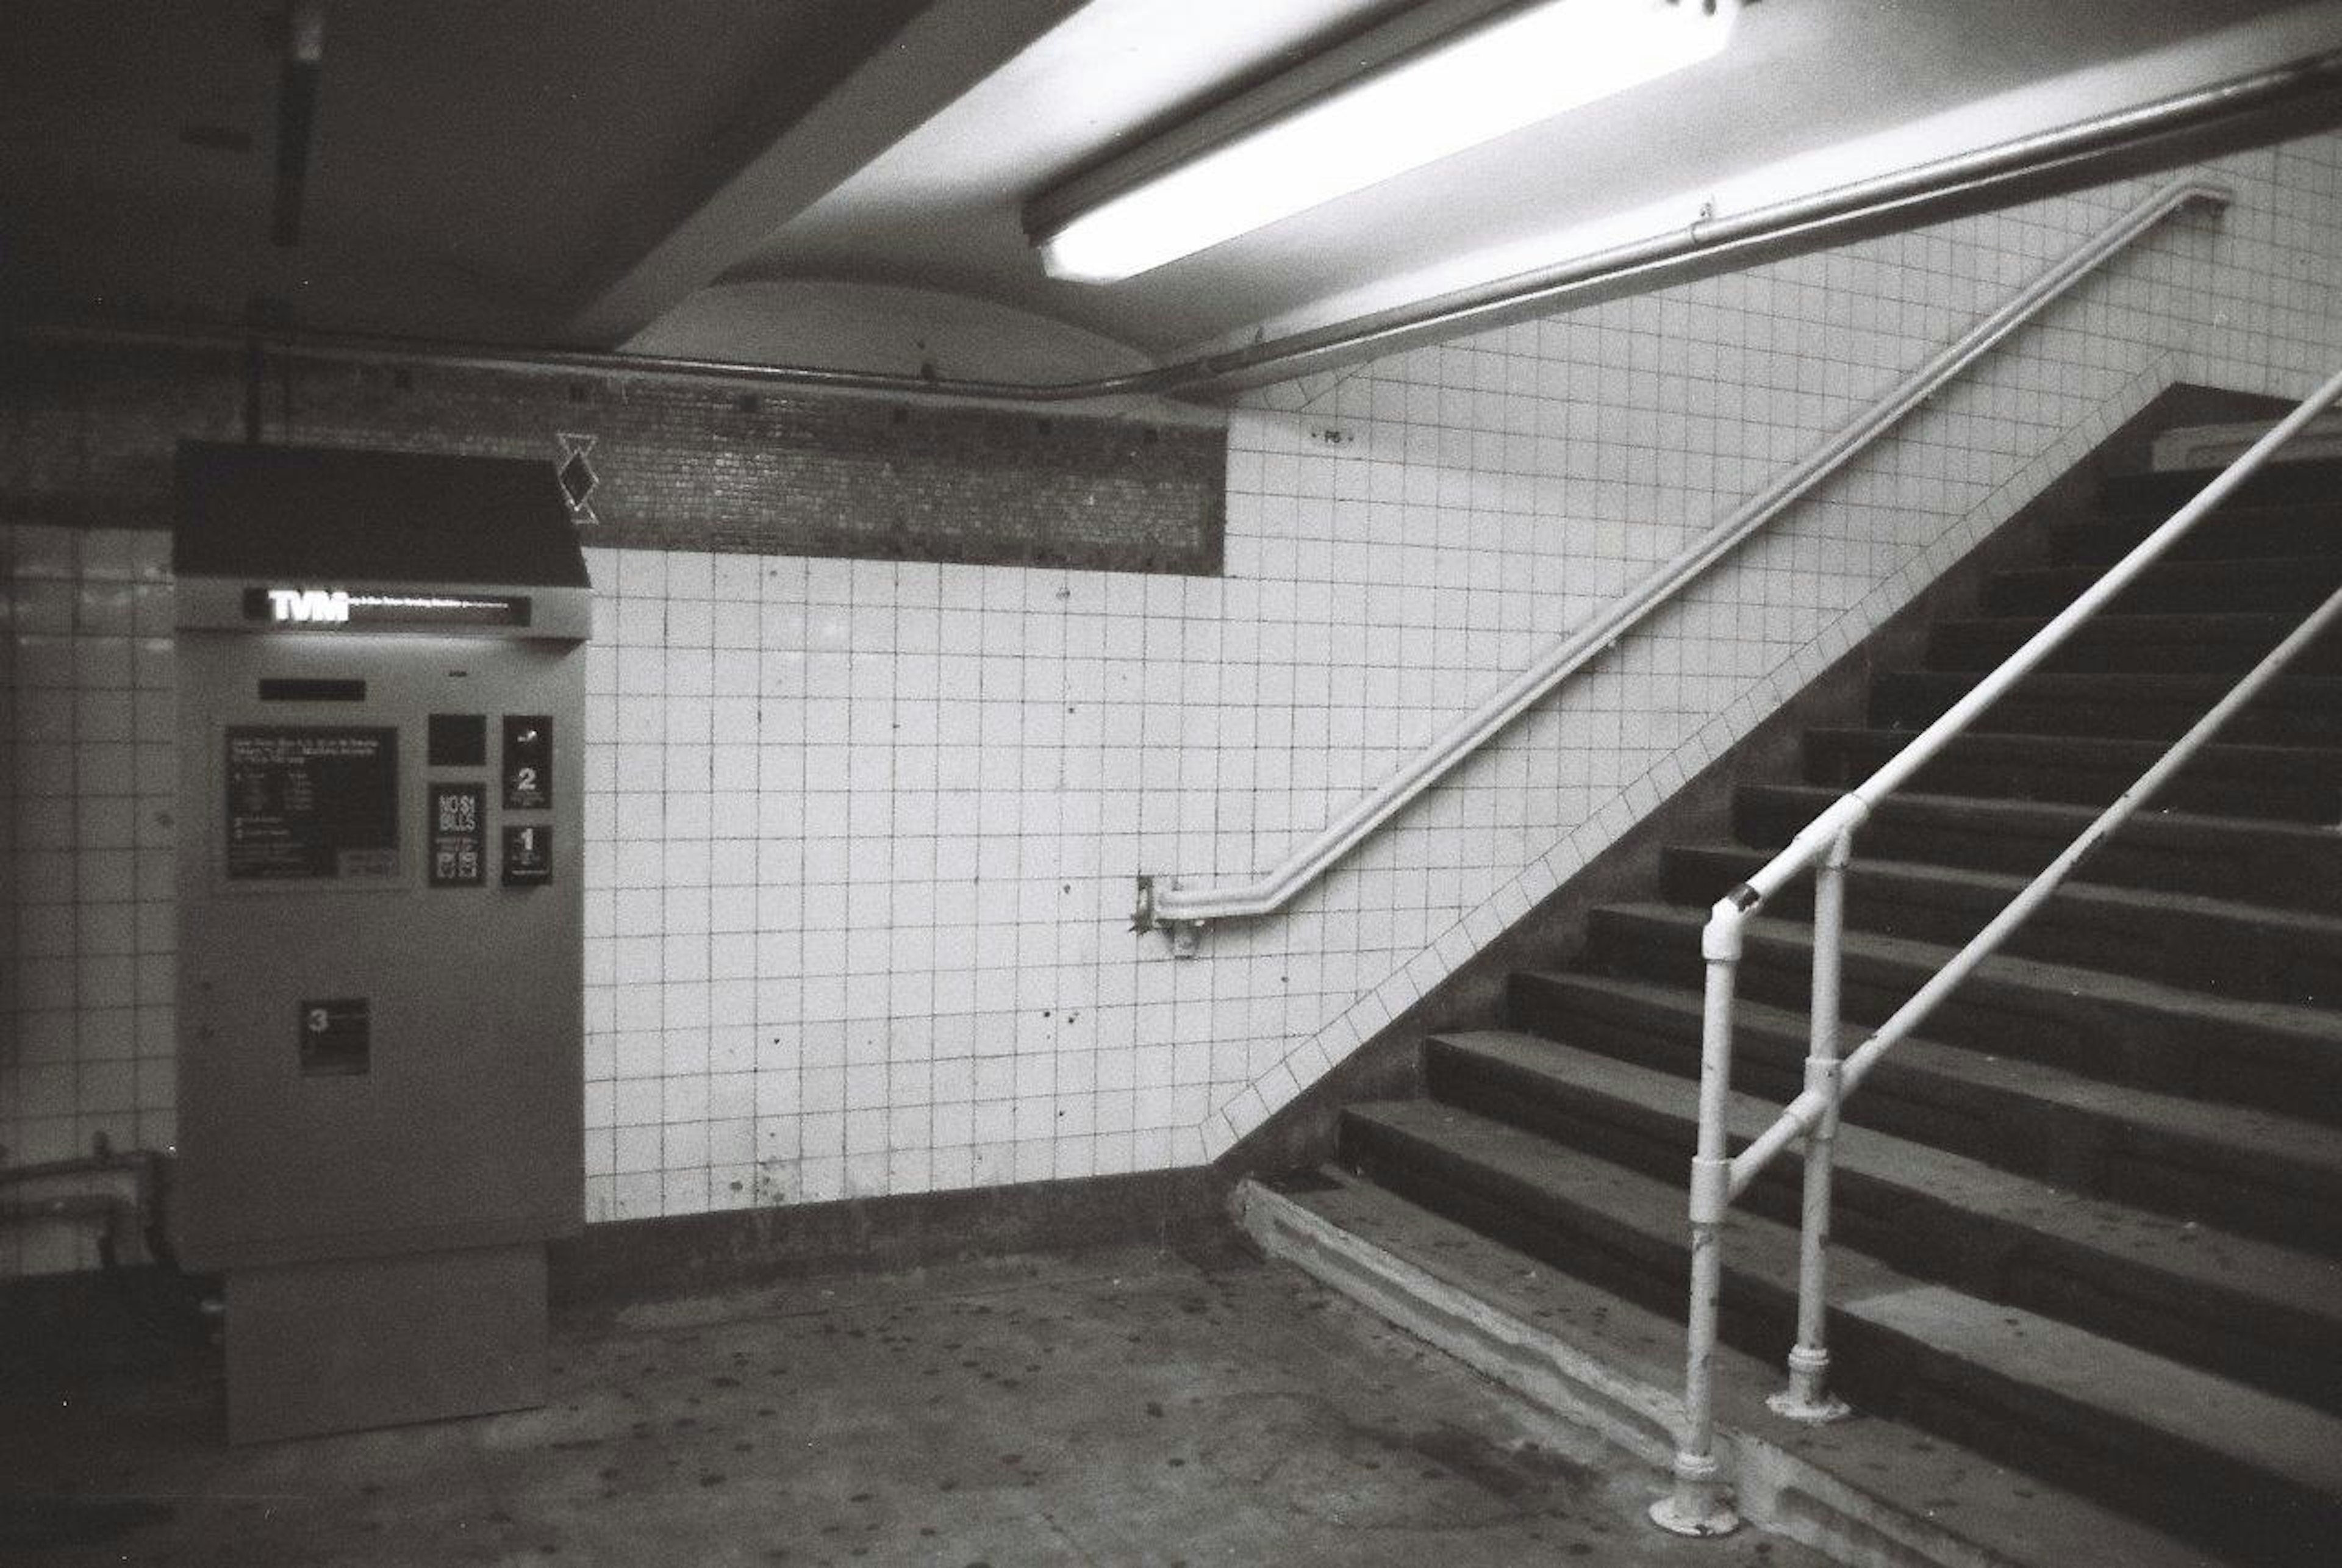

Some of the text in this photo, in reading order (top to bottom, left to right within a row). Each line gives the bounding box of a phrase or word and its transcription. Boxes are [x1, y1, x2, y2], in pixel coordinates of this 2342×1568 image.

[268, 590, 349, 621] TVM
[518, 767, 536, 790] 2
[439, 795, 458, 813] NO
[440, 814, 476, 831] BILLS
[521, 828, 534, 850] 1
[309, 1009, 329, 1031] 3
